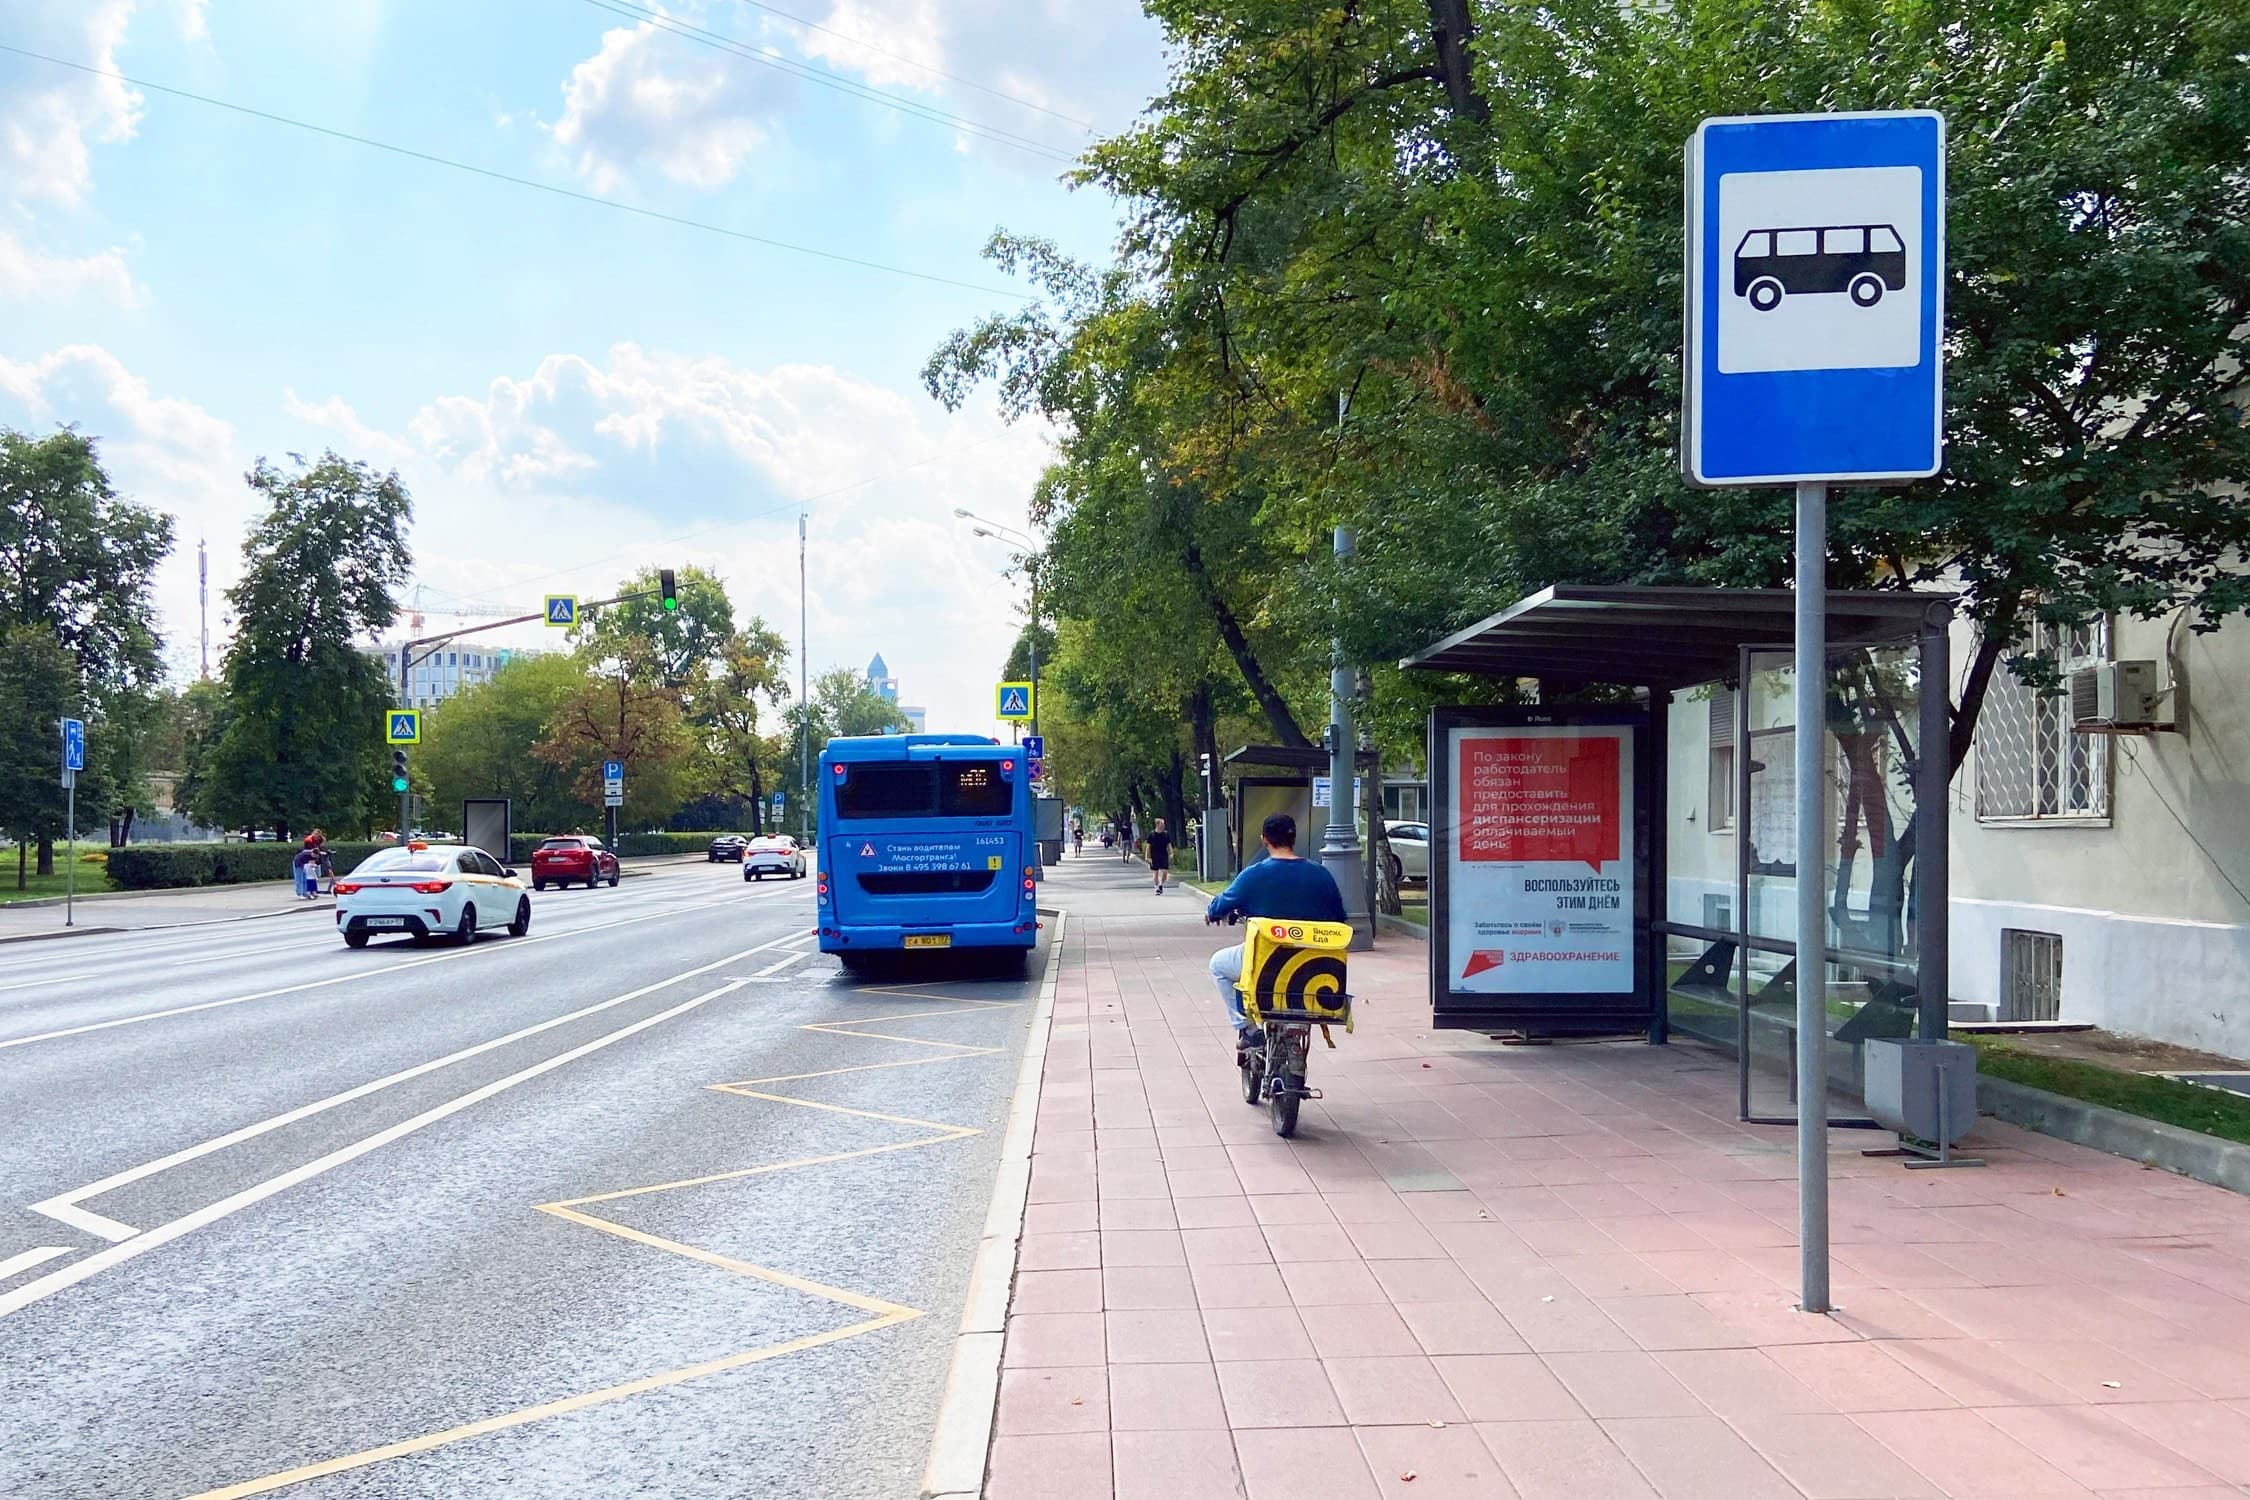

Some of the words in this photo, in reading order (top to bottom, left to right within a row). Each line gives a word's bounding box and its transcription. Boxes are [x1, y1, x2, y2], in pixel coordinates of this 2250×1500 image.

[1473, 751, 1492, 762] По
[1495, 752, 1543, 763] закону
[608, 763, 619, 777] P
[1473, 764, 1567, 776] работодатель
[1473, 776, 1521, 787] обязан
[1473, 789, 1568, 800] предоставить
[1473, 802, 1498, 813] для
[1501, 801, 1596, 813] прохождения
[1472, 814, 1601, 826] диспансеризации
[886, 844, 912, 852] Стань
[905, 863, 911, 871] 8
[913, 863, 929, 871] 495
[931, 862, 948, 871] 398
[949, 862, 959, 870] 67
[961, 862, 971, 870] 61
[1524, 877, 1621, 892] ВОСПОЛЬЗУЙТЕСЬ
[1556, 896, 1586, 910] ЭТИМ
[1588, 894, 1620, 910] ДНЁМ
[1274, 927, 1283, 937] Я
[1312, 927, 1342, 936] Яндекс
[1312, 935, 1329, 943] Еда
[1509, 951, 1620, 962] ЗДРАВООХРАНЕНИЕ
